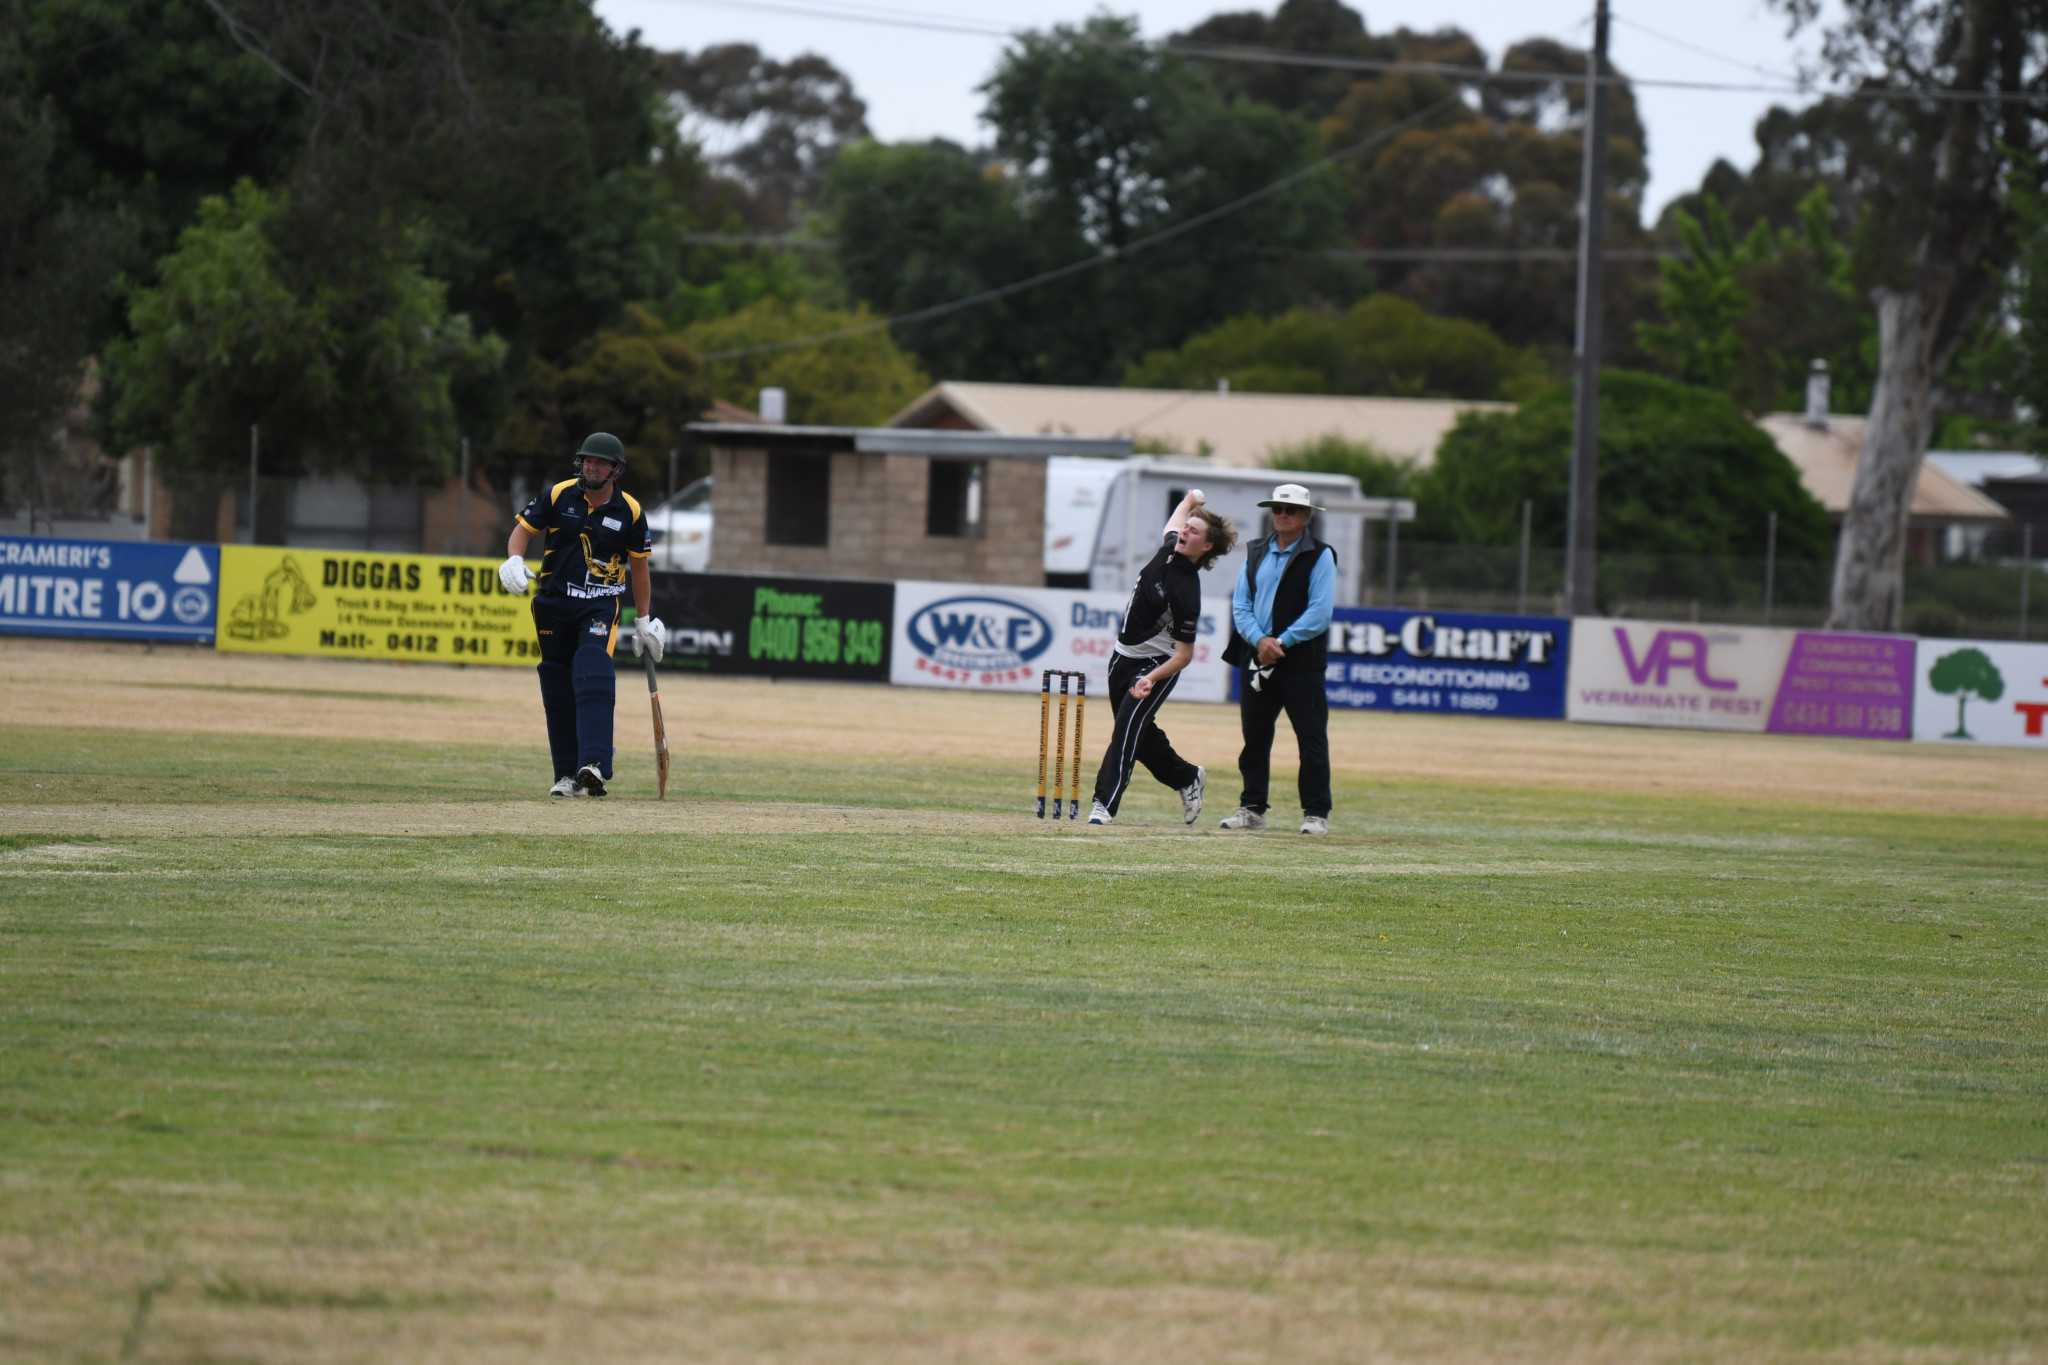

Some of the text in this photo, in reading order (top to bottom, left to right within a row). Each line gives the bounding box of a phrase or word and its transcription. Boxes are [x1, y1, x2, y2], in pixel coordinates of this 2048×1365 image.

[322, 558, 421, 592] DIGGAS
[439, 566, 541, 596] TRU
[116, 580, 166, 621] 10
[754, 586, 823, 616] Phone:
[929, 612, 1034, 651] W&F
[1071, 601, 1127, 635] Dary
[387, 633, 438, 652] 0412
[453, 637, 488, 655] 941
[1071, 637, 1117, 657] 042
[1349, 663, 1531, 692] RECONDITIONING
[1580, 688, 1764, 716] VERMINATE PEST
